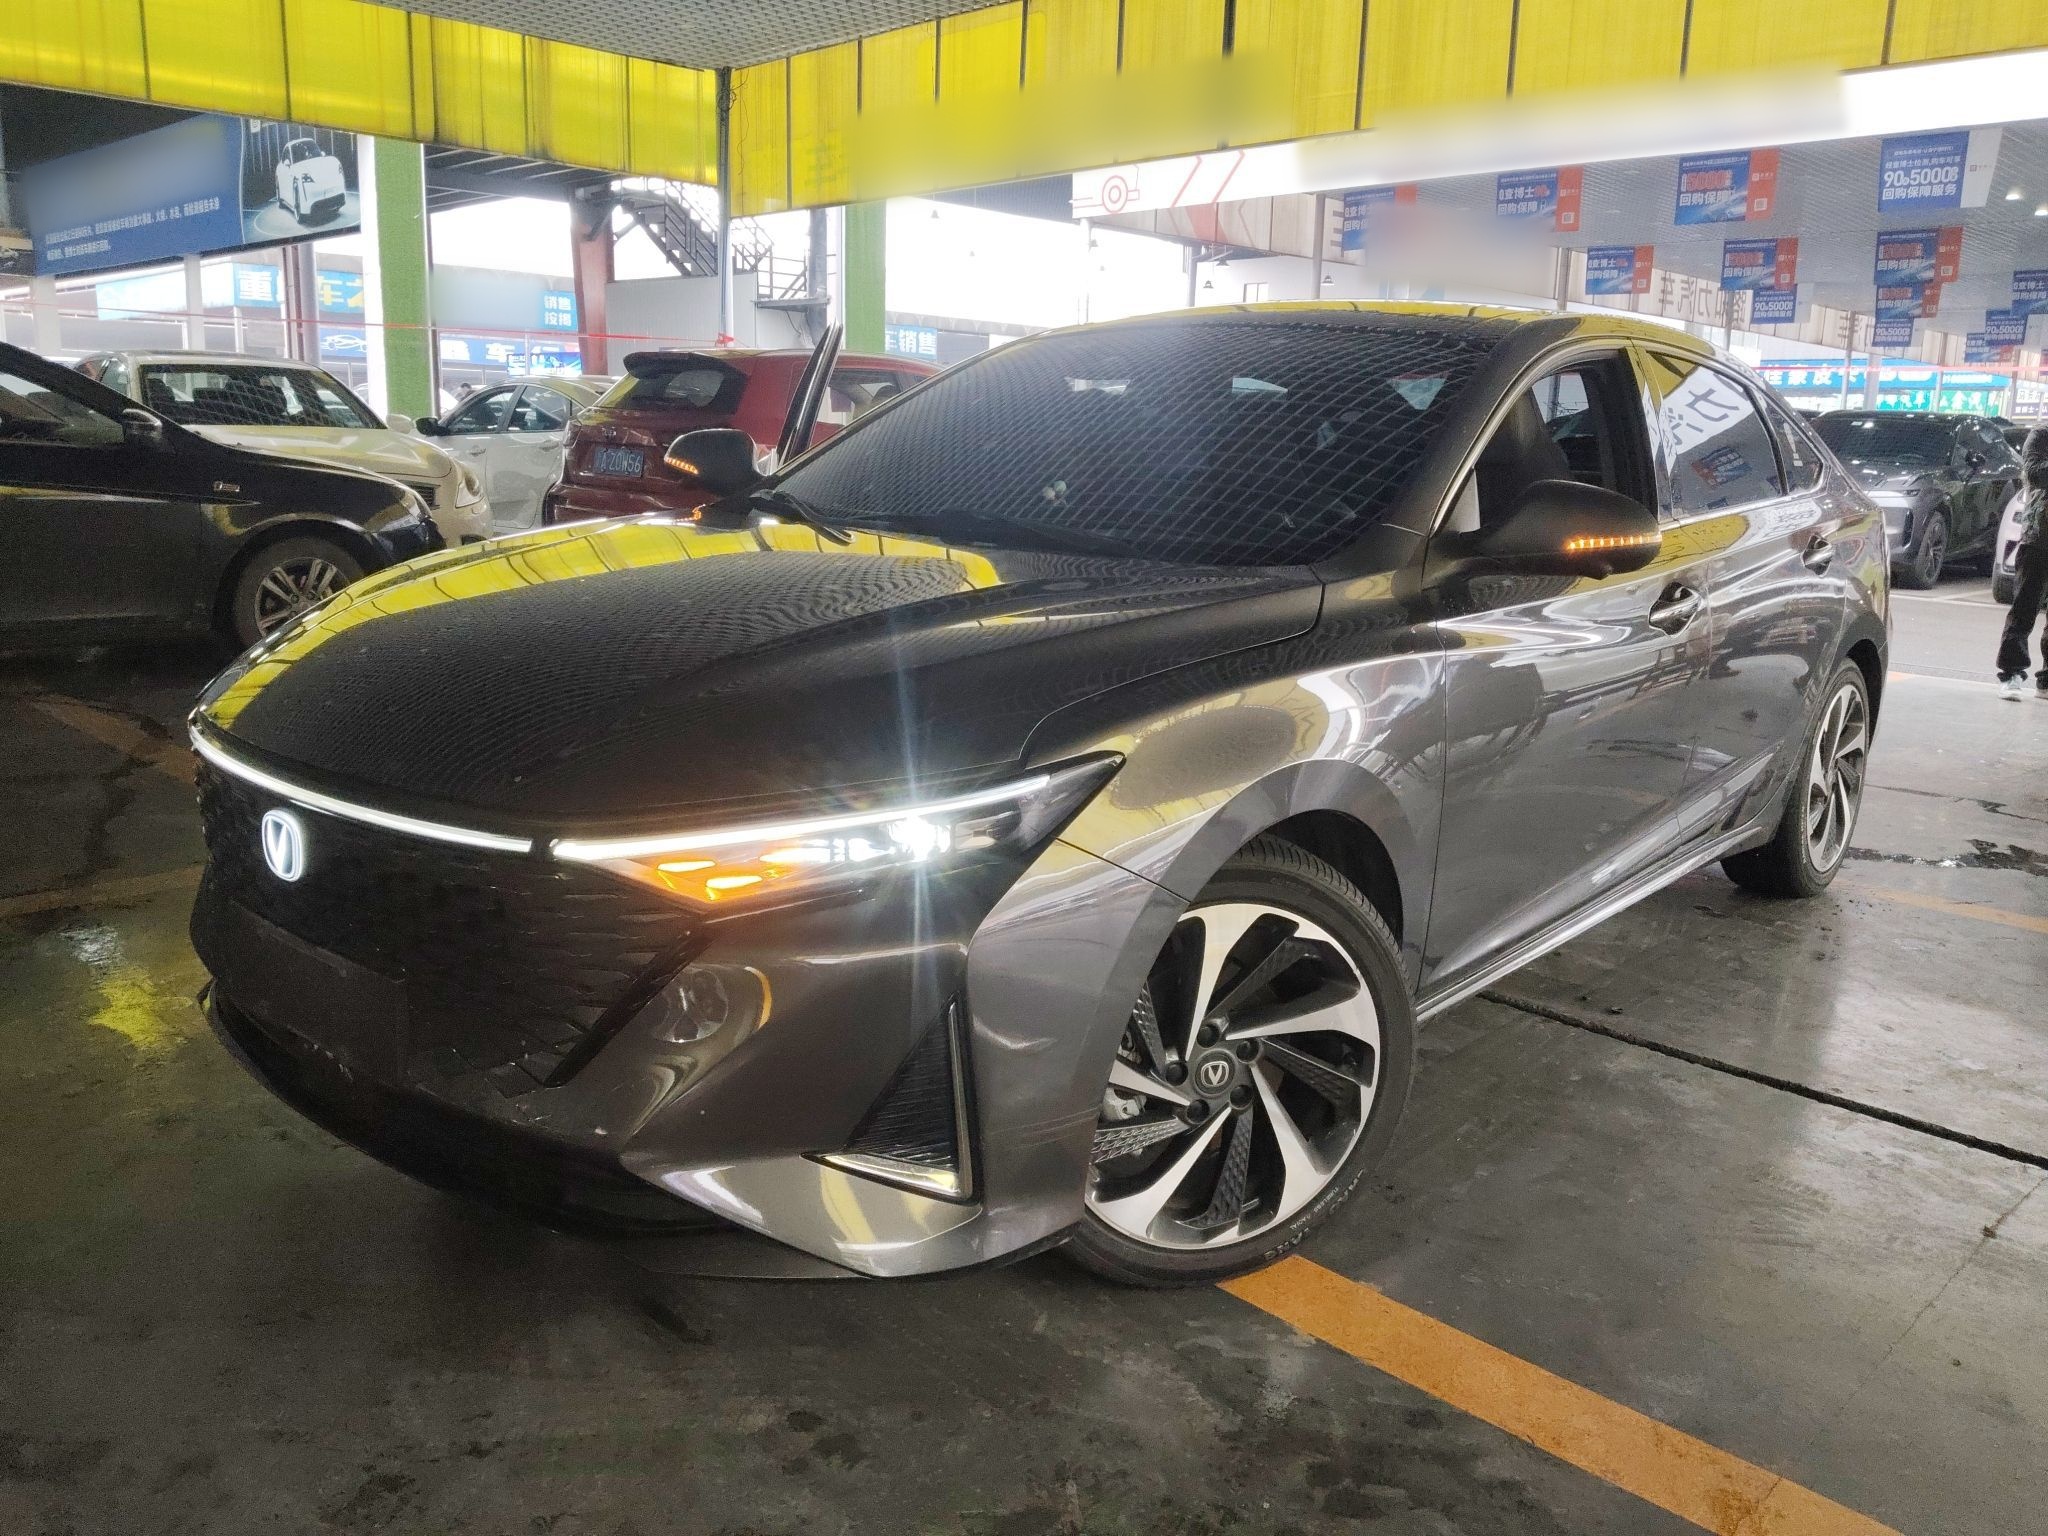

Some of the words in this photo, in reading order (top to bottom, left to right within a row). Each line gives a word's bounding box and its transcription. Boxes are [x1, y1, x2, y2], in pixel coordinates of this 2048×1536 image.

[1882, 183, 1957, 201] 回购保障服务
[544, 295, 572, 311] 销售
[544, 312, 572, 327] 按揭
